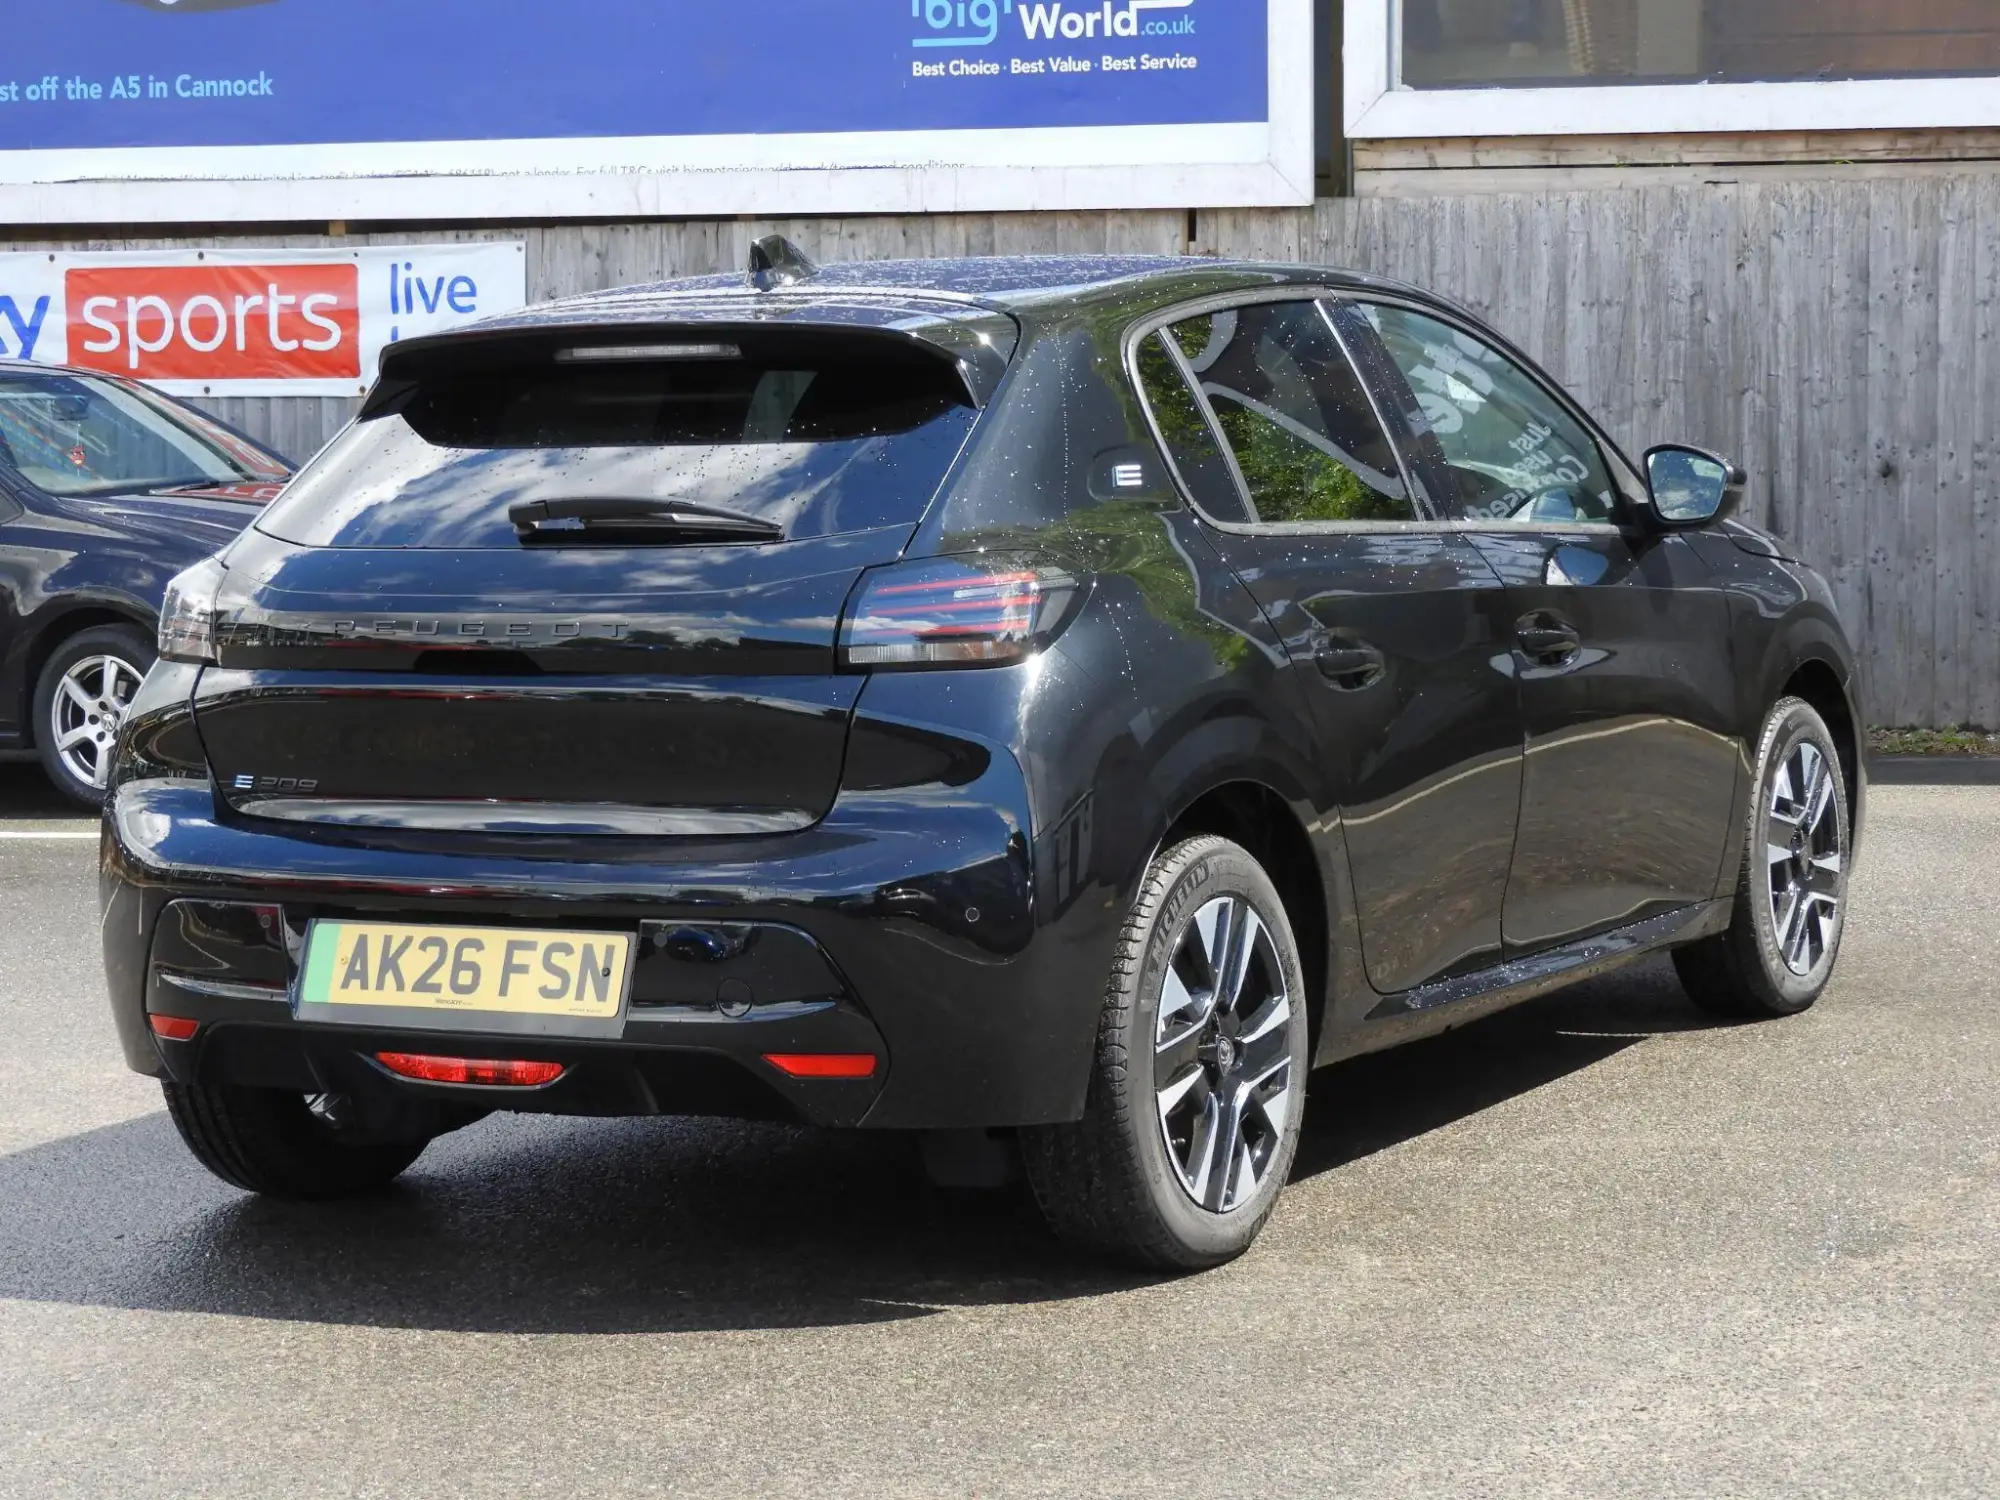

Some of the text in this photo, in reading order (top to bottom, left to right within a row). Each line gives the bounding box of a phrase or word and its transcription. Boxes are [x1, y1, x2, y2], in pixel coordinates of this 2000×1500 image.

[1018, 1, 1196, 40] World .co.uk
[912, 53, 1197, 76] Best Choice Best Value Best Service
[25, 76, 59, 101] off
[65, 76, 102, 100] the
[110, 76, 141, 98] A5
[149, 75, 168, 98] in
[175, 71, 273, 98] Cannock
[391, 262, 478, 314] live
[83, 283, 342, 369] sports
[334, 620, 629, 639] PEUGEOT
[340, 933, 616, 1002] AK26 FSN
